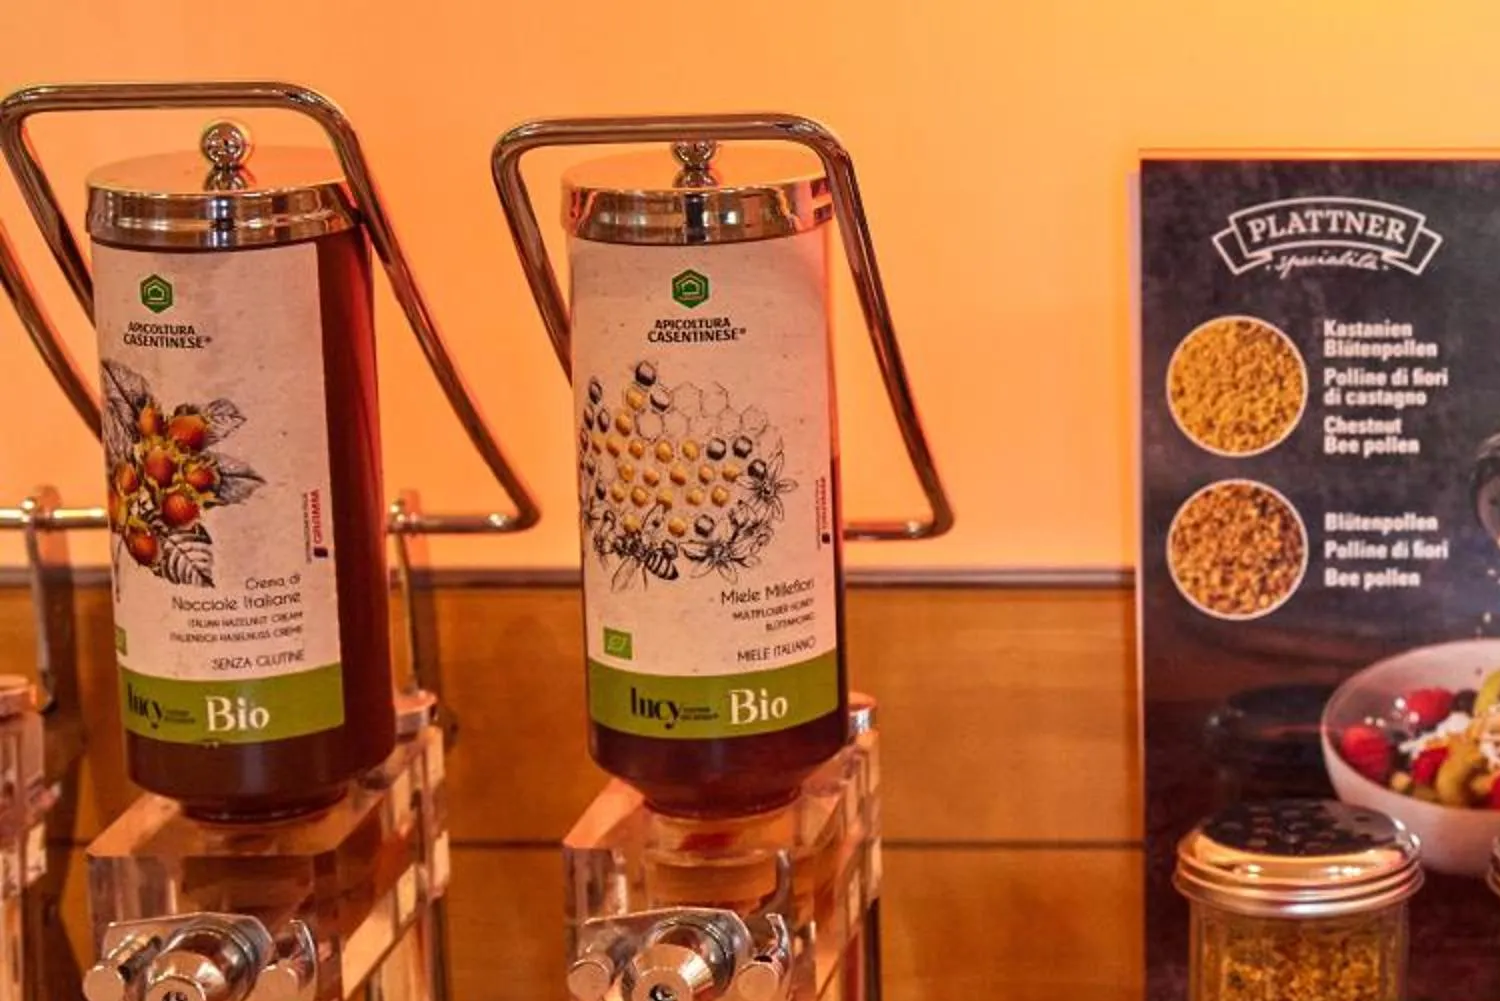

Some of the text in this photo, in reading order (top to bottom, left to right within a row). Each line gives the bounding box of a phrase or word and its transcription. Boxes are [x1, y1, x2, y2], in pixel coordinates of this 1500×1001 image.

[1247, 209, 1407, 244] PLATTNER
[127, 321, 196, 336] APICOLTURA
[654, 317, 731, 330] APICOLTURA
[1324, 318, 1413, 338] Kastanien
[1324, 338, 1438, 361] Blütenpollen
[1324, 367, 1449, 386] Polline di fiori
[1323, 387, 1427, 409] di castagno
[1324, 415, 1402, 435] Chestnut
[1324, 435, 1420, 459] Bee pollen
[1324, 511, 1438, 536] Blütenpollen
[1324, 539, 1449, 559] Polline di fiori
[245, 577, 285, 590] Crema
[1324, 567, 1420, 591] Bee pollen
[171, 592, 301, 611] Nocciole Italiane
[721, 587, 761, 605] Miele
[212, 657, 251, 670] SENZA
[737, 647, 771, 662] MIELE
[205, 695, 270, 732] Bio
[729, 688, 789, 725] Bio
